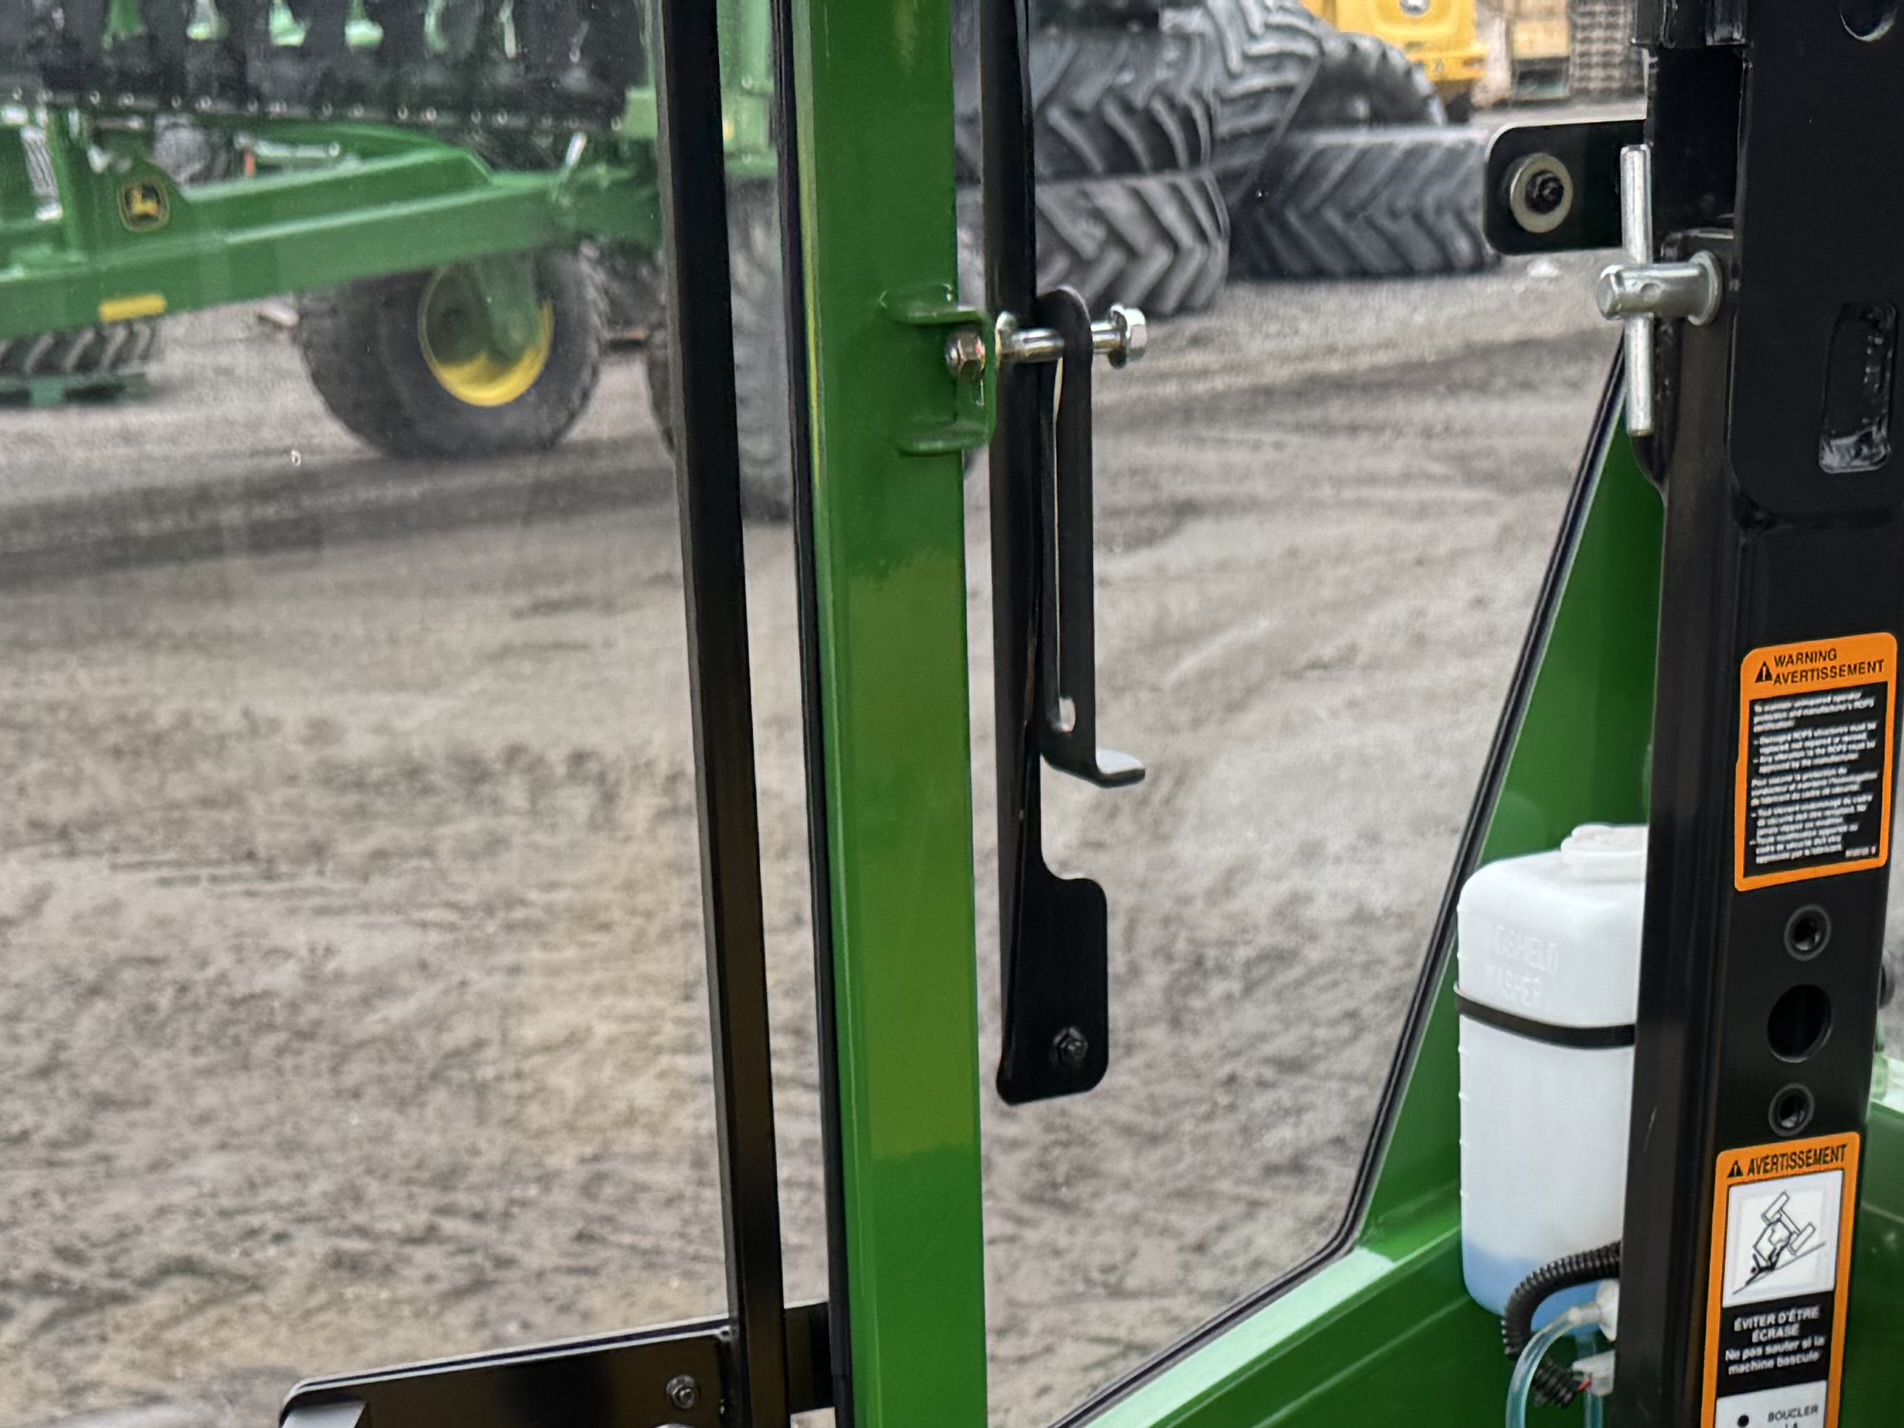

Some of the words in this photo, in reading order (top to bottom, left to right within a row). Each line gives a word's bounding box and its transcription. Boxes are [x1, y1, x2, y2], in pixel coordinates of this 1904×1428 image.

[1774, 648, 1837, 668] WARNING
[1774, 659, 1885, 685] AVERTISSEMENT
[1747, 1143, 1848, 1176] AVERTISSEMENT
